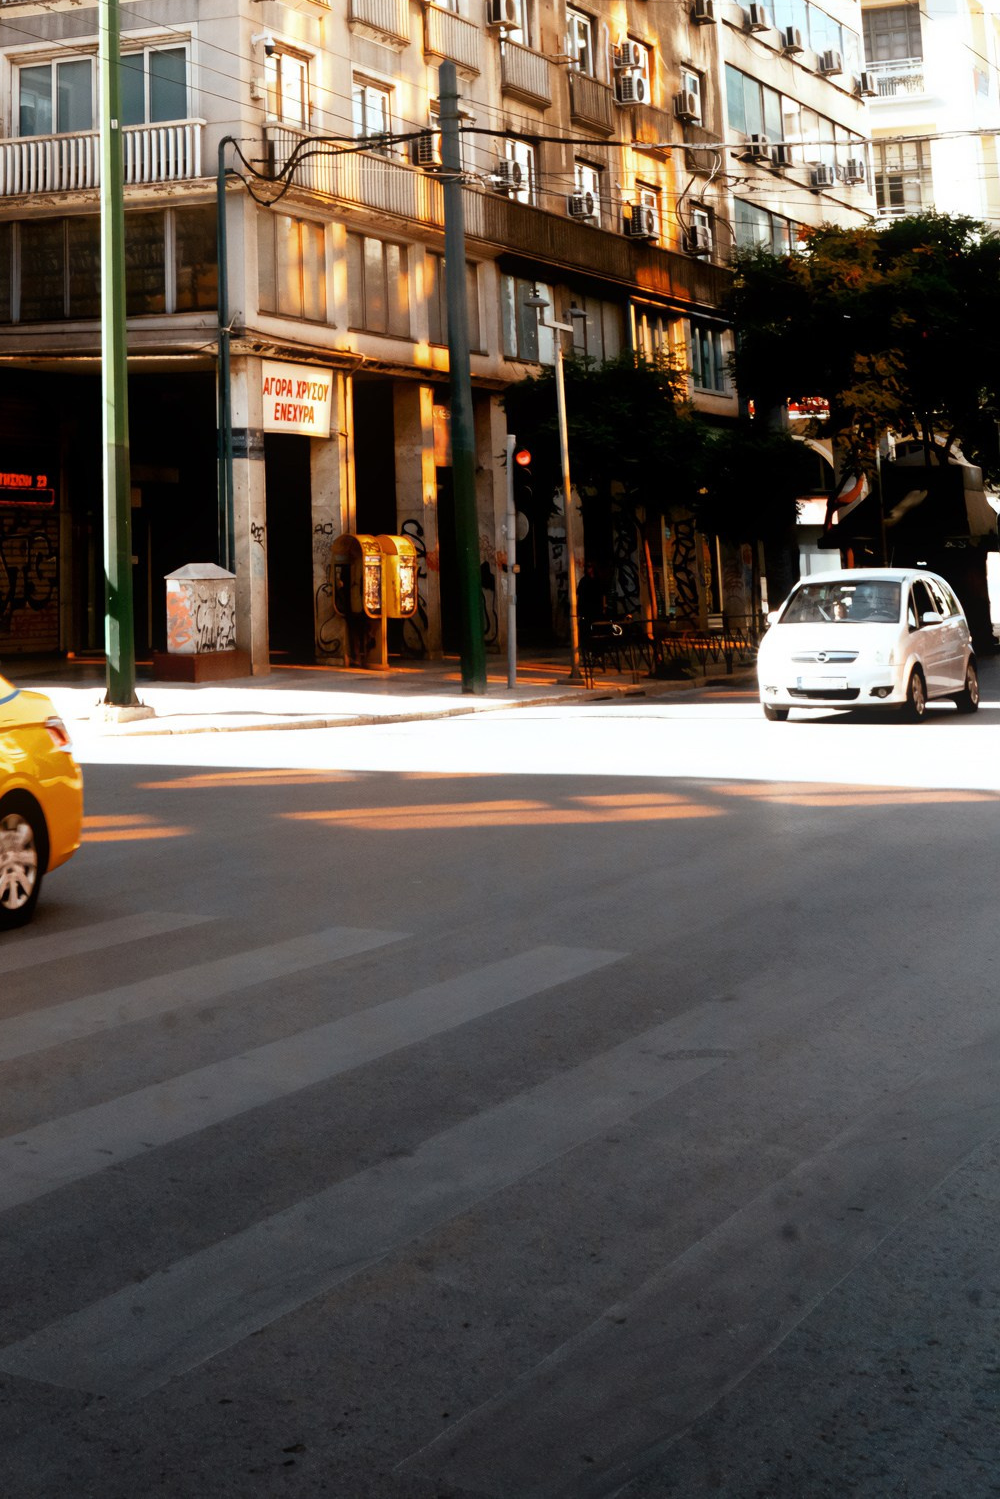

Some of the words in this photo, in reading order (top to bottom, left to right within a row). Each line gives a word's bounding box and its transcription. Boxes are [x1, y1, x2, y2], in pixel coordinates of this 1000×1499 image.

[262, 377, 293, 398] ΑΓΟΡΑ
[295, 380, 330, 402] ΧΡΥΣΟΥ
[274, 402, 315, 424] ΕΝΕΧΥΡΑ
